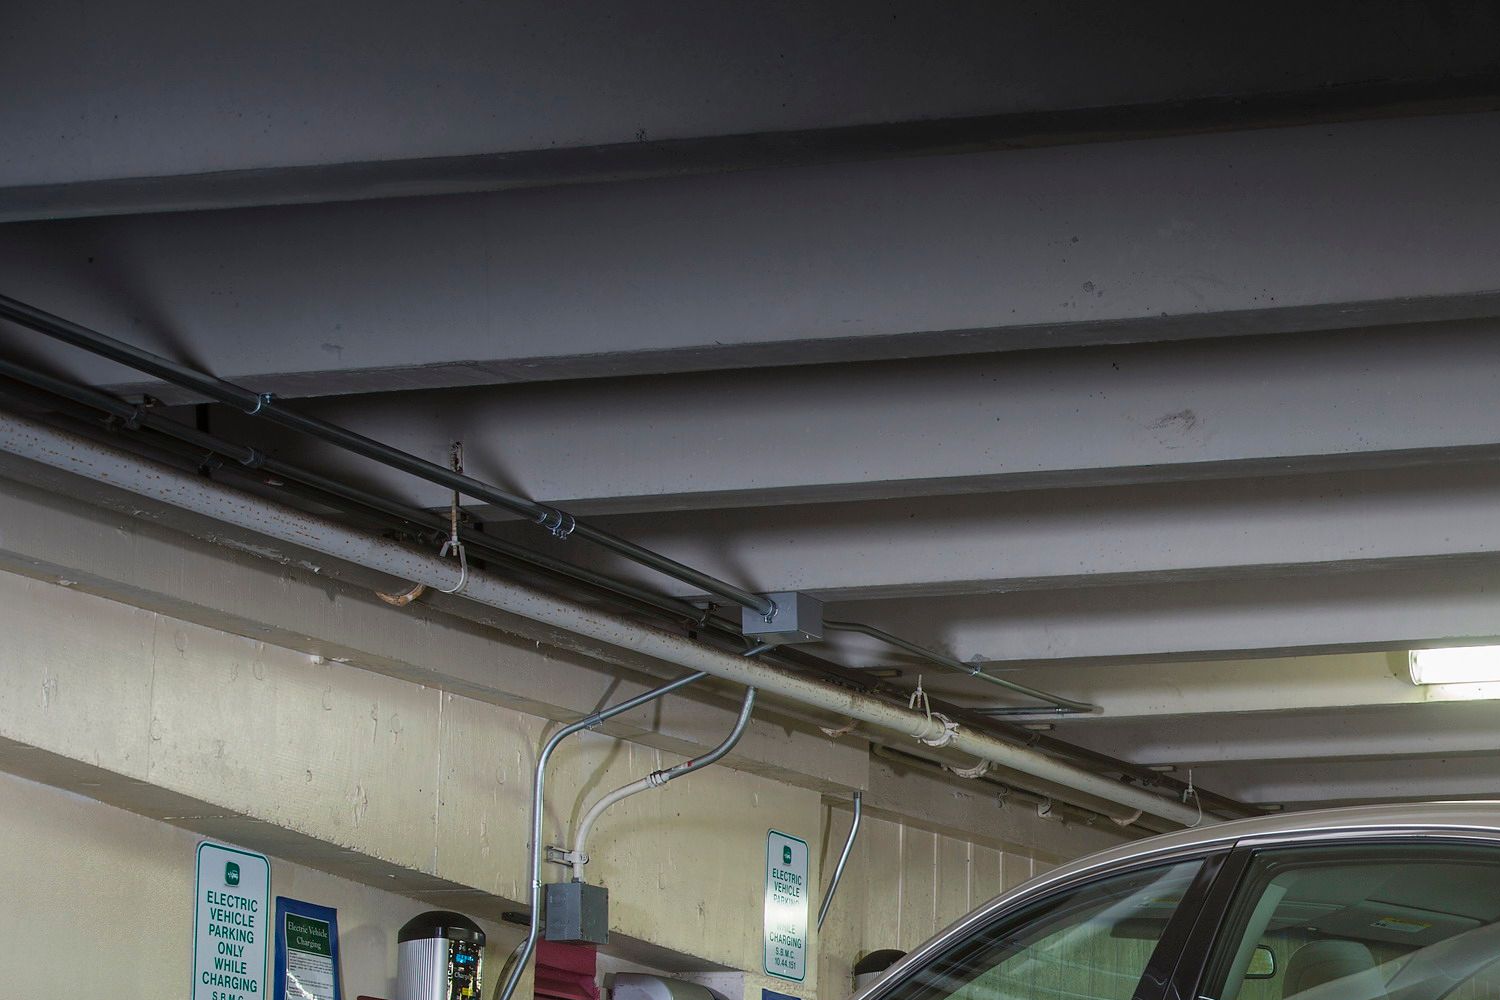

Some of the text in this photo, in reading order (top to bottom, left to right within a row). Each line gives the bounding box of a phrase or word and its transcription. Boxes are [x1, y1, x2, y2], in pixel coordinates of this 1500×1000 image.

[772, 868, 802, 886] ELECTRIC
[774, 881, 800, 898] VEHICLE
[207, 890, 258, 913] ELECTRIC
[210, 907, 255, 928] VEHICLE
[209, 923, 254, 944] PARKING
[287, 921, 328, 938] Electric Vehicle
[217, 941, 244, 957] ONLY
[296, 936, 322, 950] Charging
[769, 931, 801, 949] CHARGING
[214, 957, 247, 975] WHILE
[774, 957, 796, 970] 10.44.151
[202, 971, 257, 993] CHARGING
